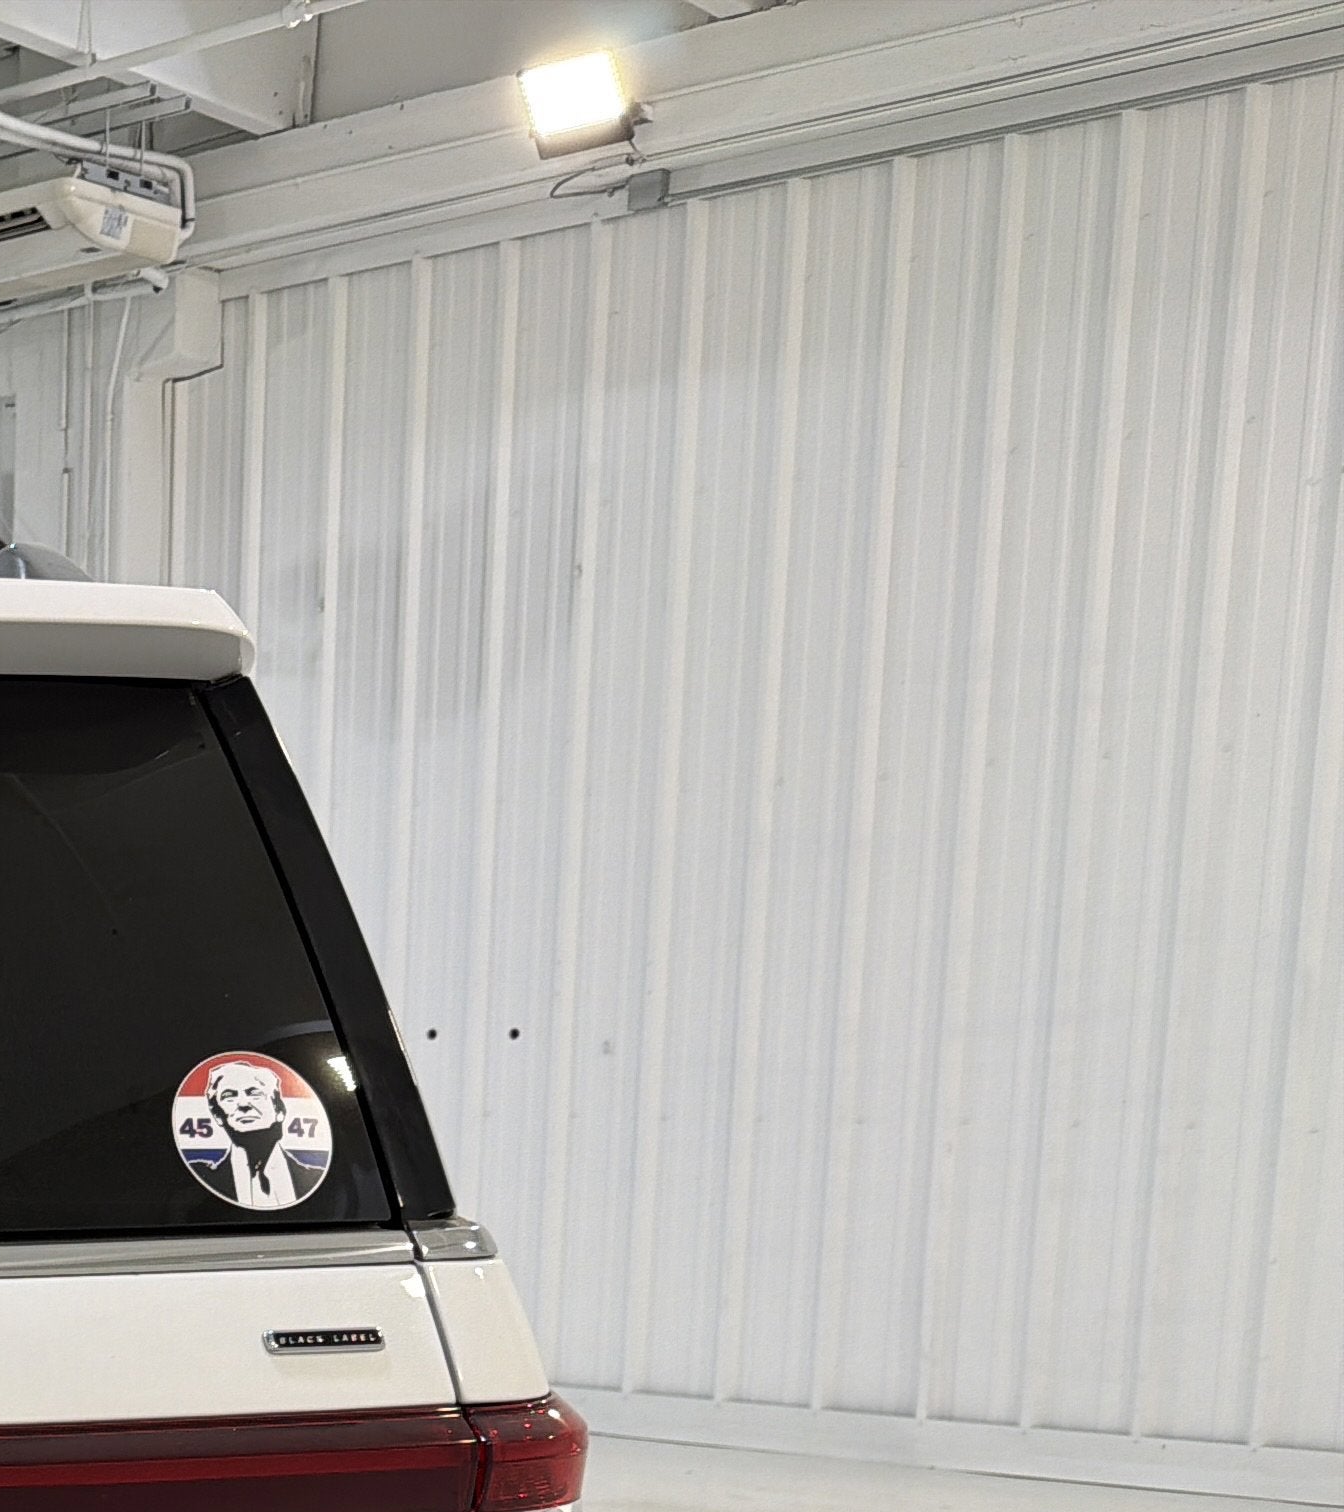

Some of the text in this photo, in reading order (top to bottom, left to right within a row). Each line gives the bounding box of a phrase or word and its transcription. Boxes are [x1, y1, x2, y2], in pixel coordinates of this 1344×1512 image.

[179, 1117, 214, 1138] 45
[287, 1117, 319, 1138] 47
[279, 1333, 377, 1345] BLACK LABEL
